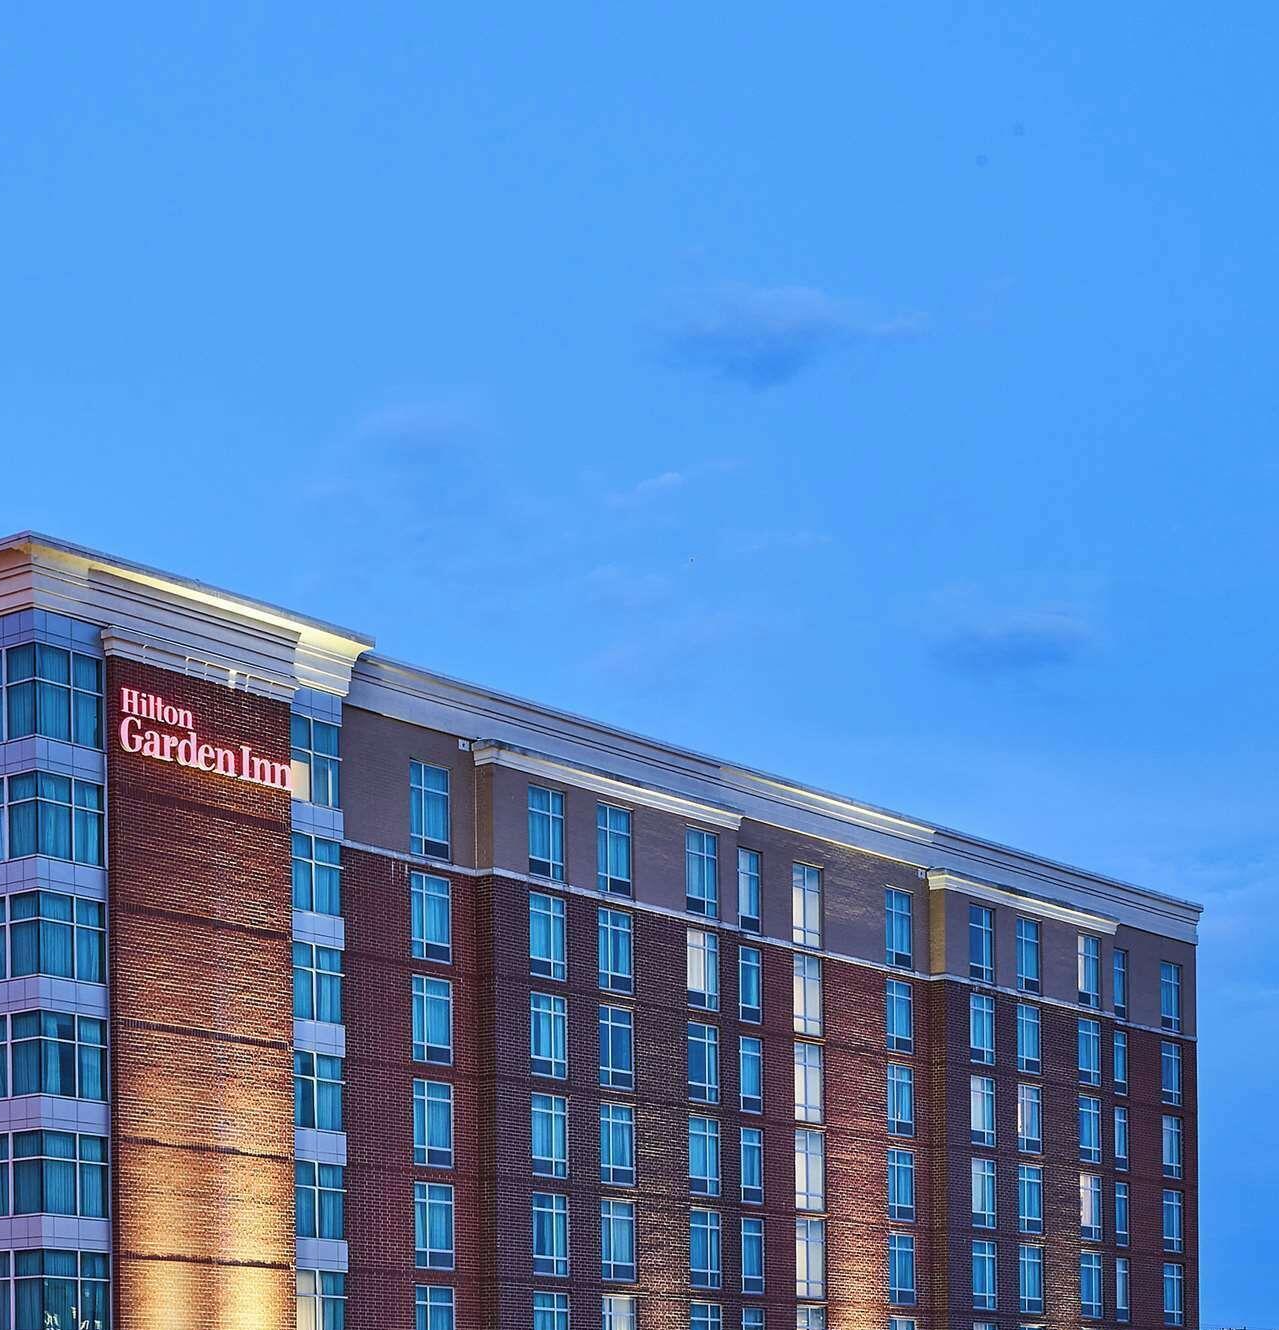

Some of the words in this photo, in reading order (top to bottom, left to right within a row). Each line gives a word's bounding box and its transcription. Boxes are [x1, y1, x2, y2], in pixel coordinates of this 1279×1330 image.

[121, 687, 194, 730] Hilton
[120, 716, 237, 778] Garden
[239, 745, 293, 791] Inn
